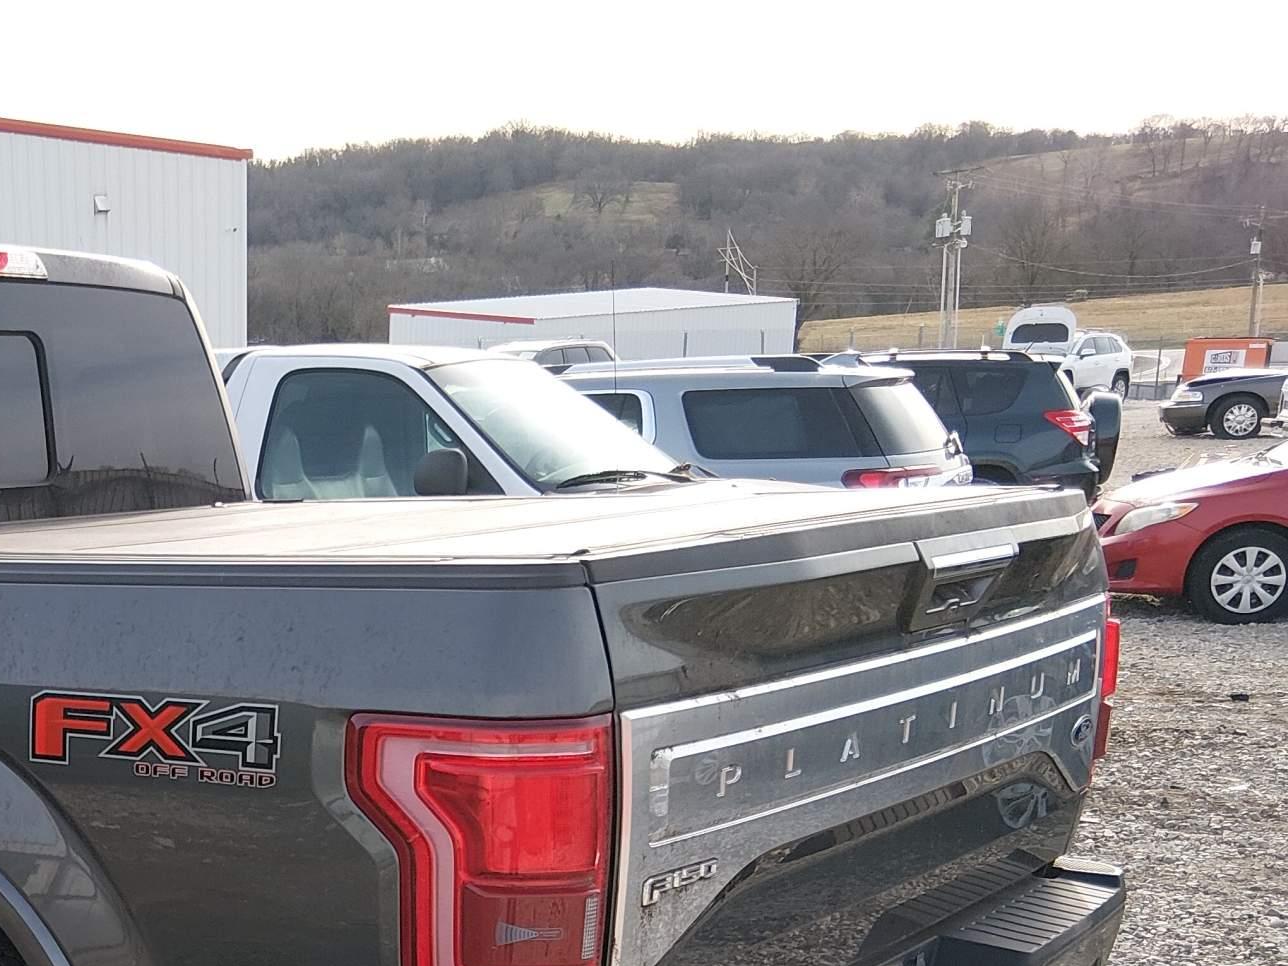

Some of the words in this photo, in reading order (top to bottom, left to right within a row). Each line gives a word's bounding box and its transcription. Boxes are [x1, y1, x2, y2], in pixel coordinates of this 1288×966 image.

[29, 689, 281, 773] FX4
[715, 657, 1082, 798] PLATINUM
[134, 761, 188, 780] OFF
[198, 768, 276, 789] ROAD
